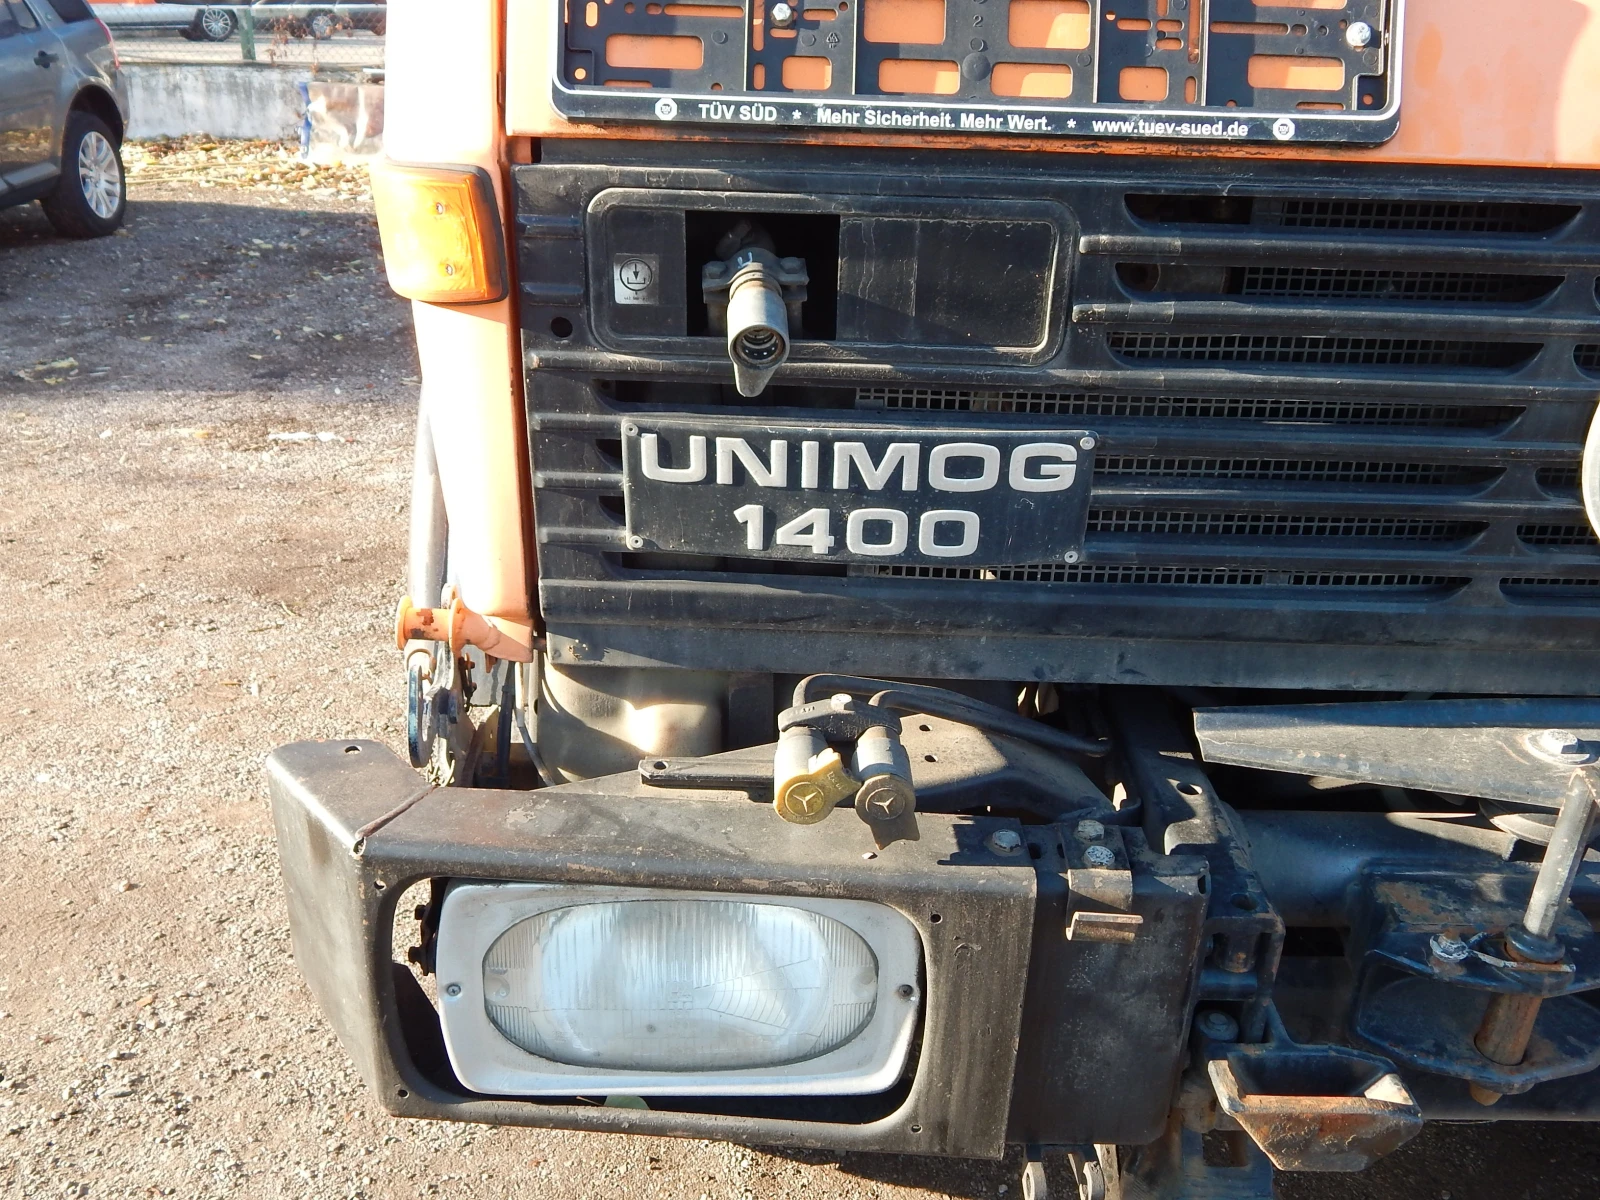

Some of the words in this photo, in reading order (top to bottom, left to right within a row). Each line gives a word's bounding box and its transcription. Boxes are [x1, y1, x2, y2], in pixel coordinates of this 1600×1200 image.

[698, 101, 735, 120] TÜV
[739, 103, 778, 122] SÜD
[816, 107, 861, 125] Mehr
[864, 109, 956, 128] Sicherheit.
[960, 112, 1004, 129] Mehr
[1007, 114, 1052, 131] Wert.
[1092, 119, 1249, 137] www.tuev-sued.de
[640, 432, 1078, 493] UNIMOG
[733, 504, 981, 558] 1400
